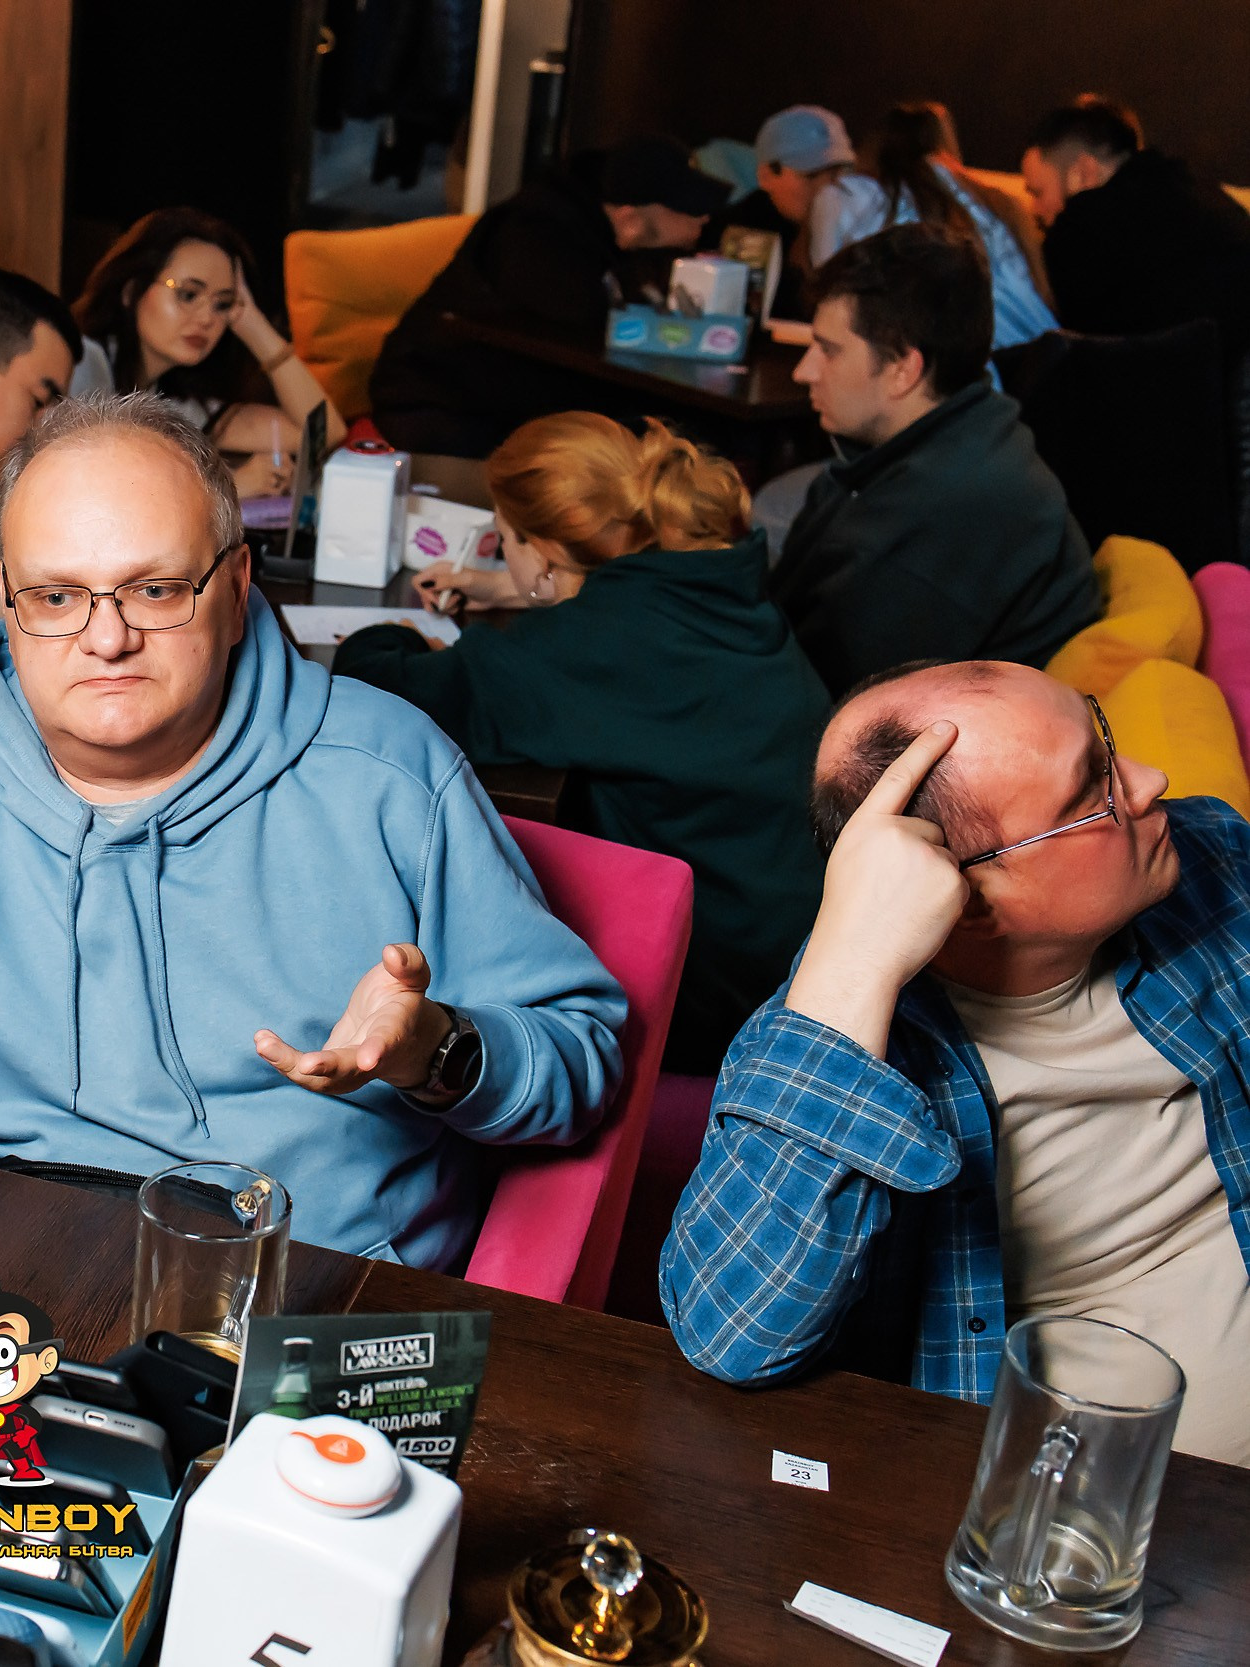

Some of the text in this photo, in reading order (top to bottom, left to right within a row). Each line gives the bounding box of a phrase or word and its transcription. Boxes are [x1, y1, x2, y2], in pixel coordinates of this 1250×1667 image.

[350, 1338, 420, 1358] WILLIAM
[346, 1349, 427, 1371] LAWSON'S
[370, 1411, 442, 1432] ПОДАРОК
[399, 1440, 452, 1453] 1500
[790, 1468, 811, 1481] 23
